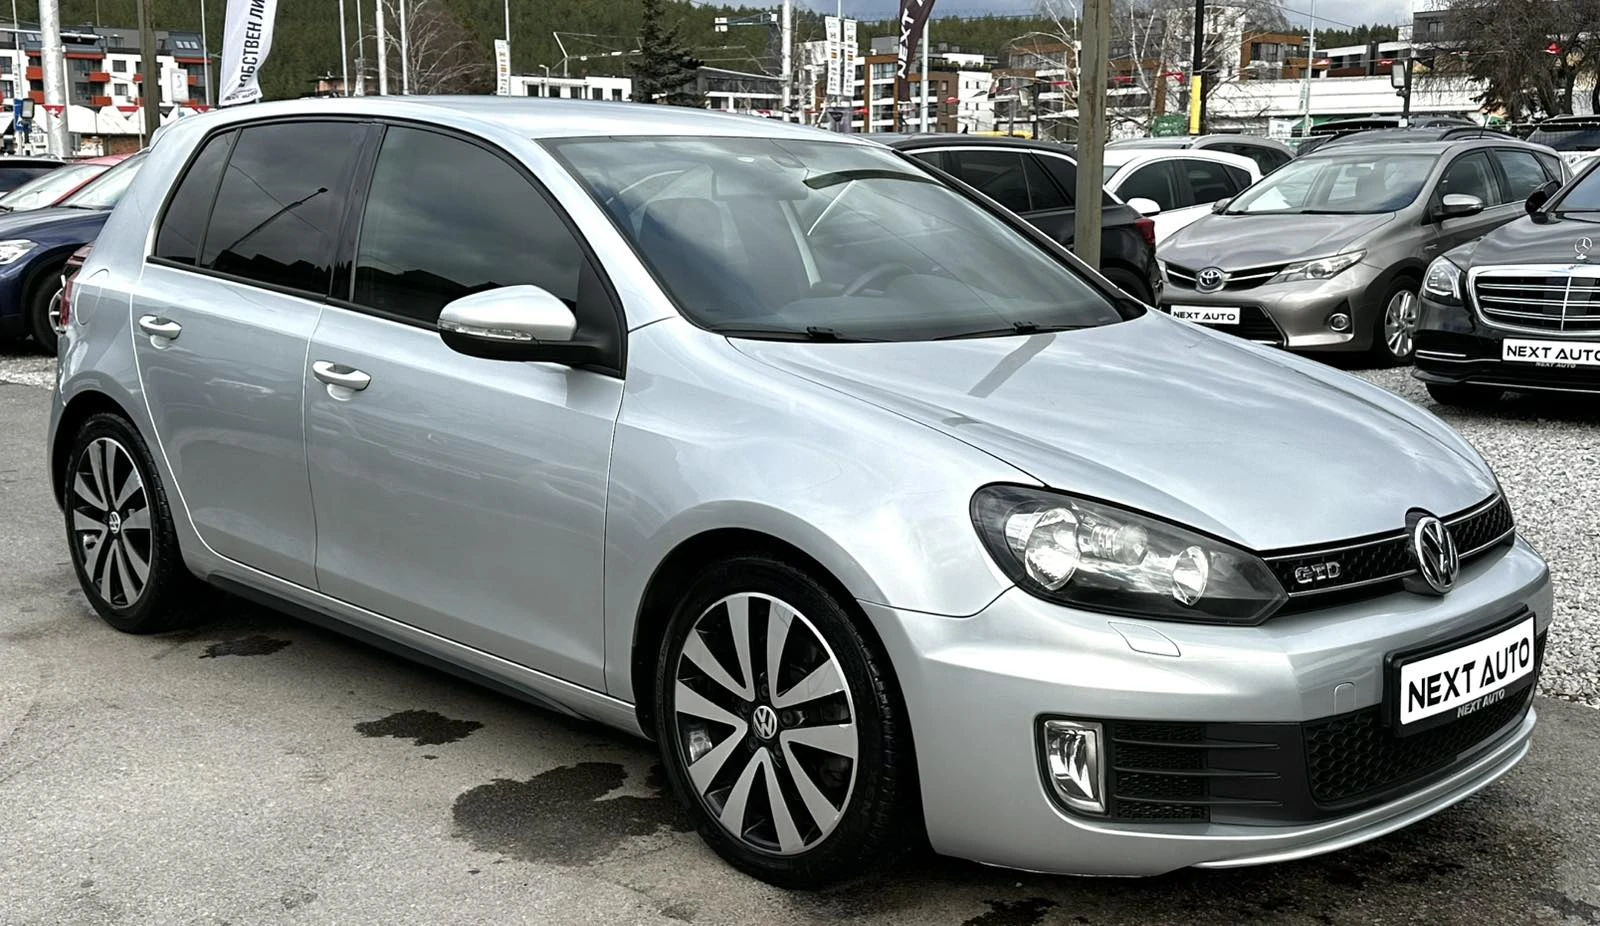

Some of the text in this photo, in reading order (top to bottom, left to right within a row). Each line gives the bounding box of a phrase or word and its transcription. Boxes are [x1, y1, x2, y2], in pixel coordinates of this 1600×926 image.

[898, 8, 915, 79] NEXT
[1173, 311, 1236, 321] NEXT AUTO
[1506, 345, 1552, 359] NEXT
[1294, 561, 1341, 584] GTD
[1408, 637, 1530, 713] NEXT AUTO
[1457, 688, 1505, 718] NEXT AUTO
